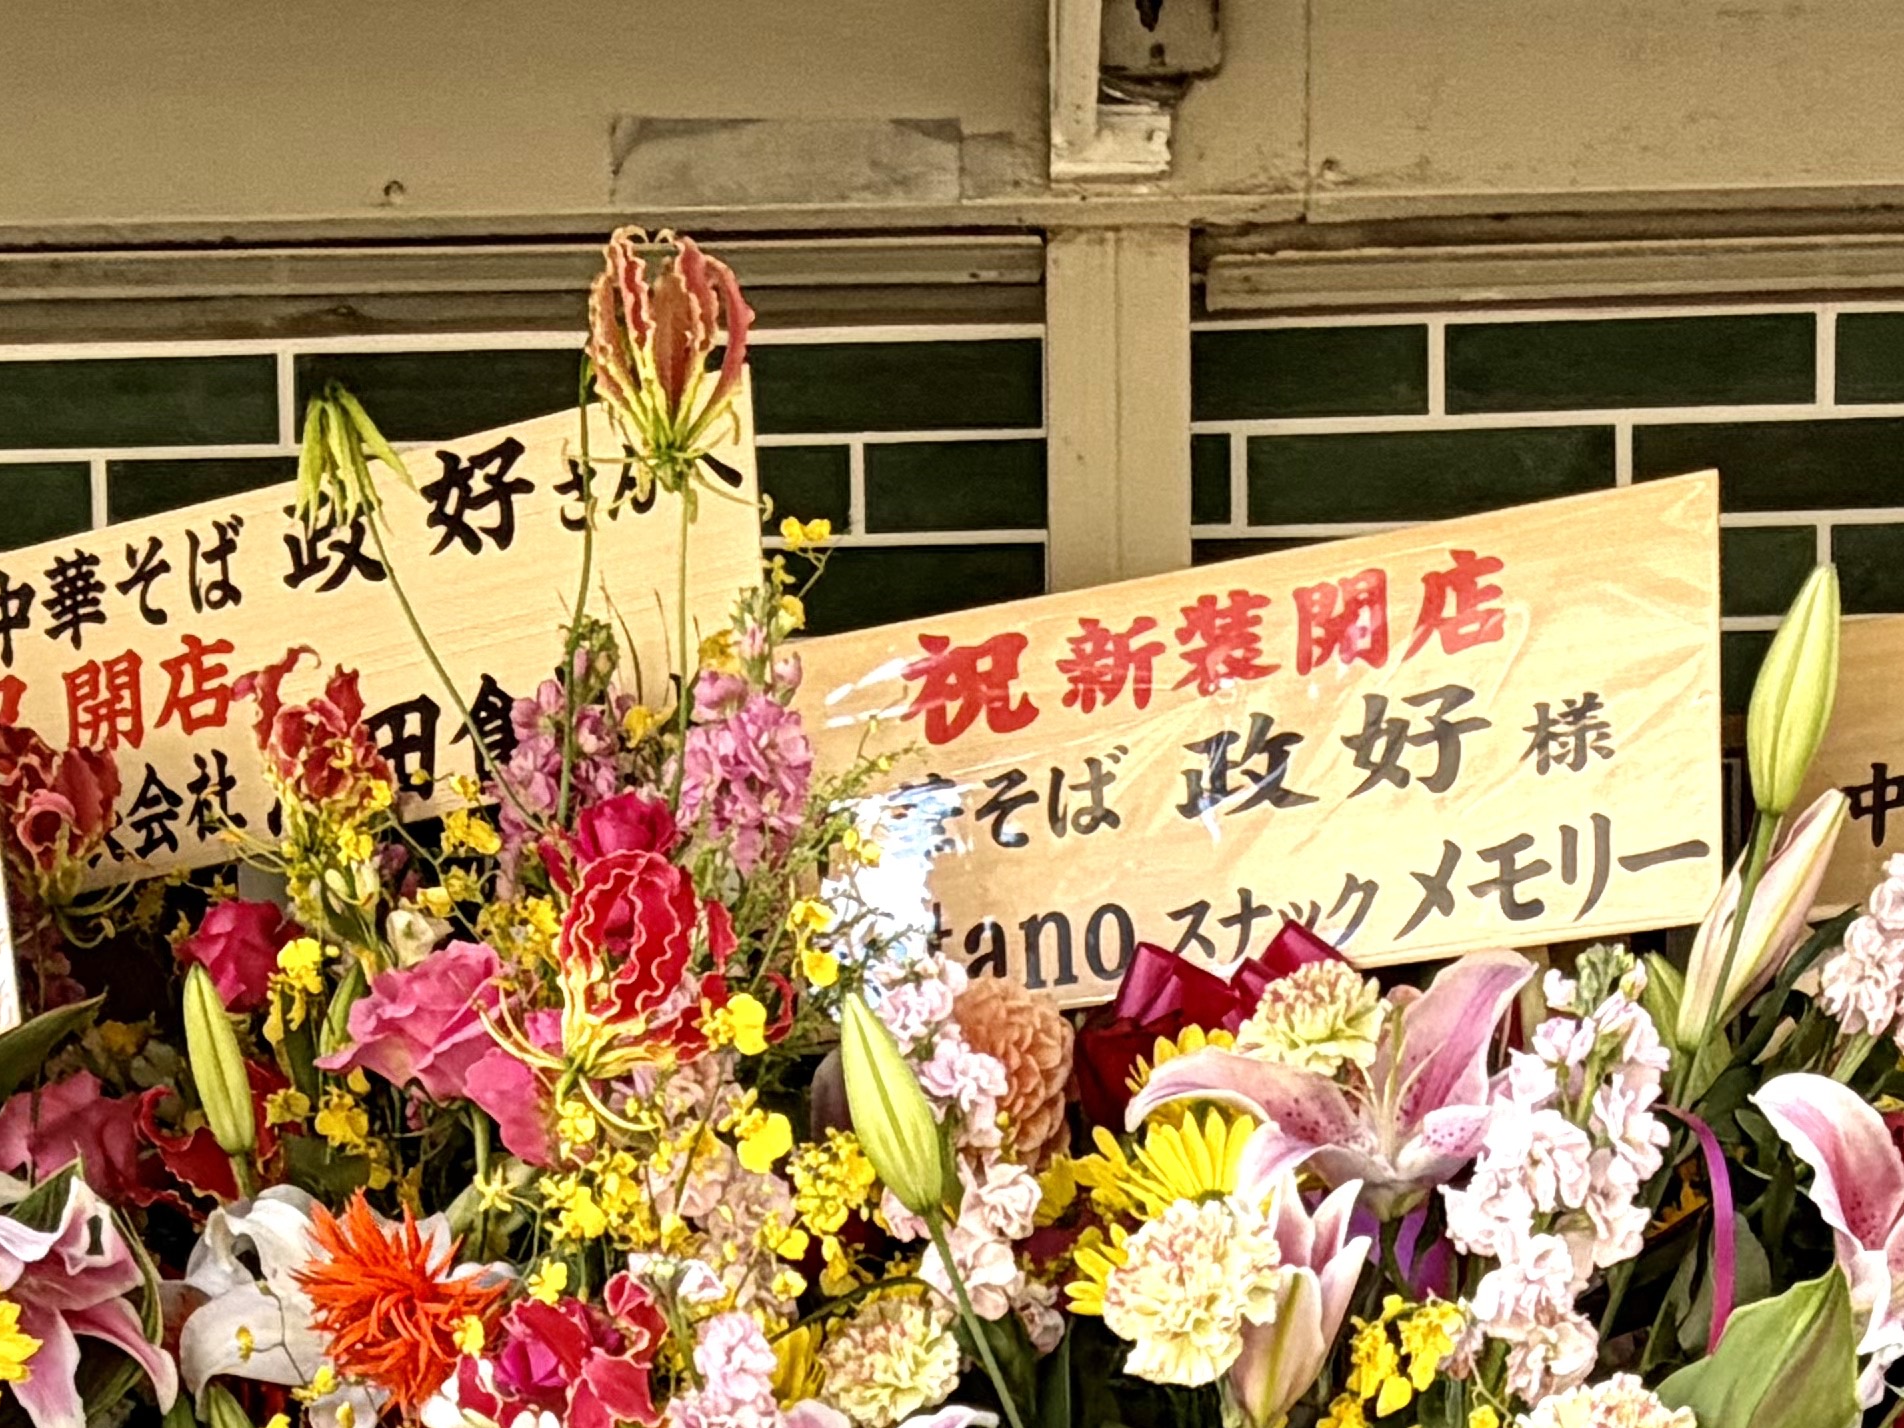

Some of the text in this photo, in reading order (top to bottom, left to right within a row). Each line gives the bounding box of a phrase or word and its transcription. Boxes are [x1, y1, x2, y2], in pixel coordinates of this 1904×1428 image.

[900, 547, 1507, 745] 祝新装開店
